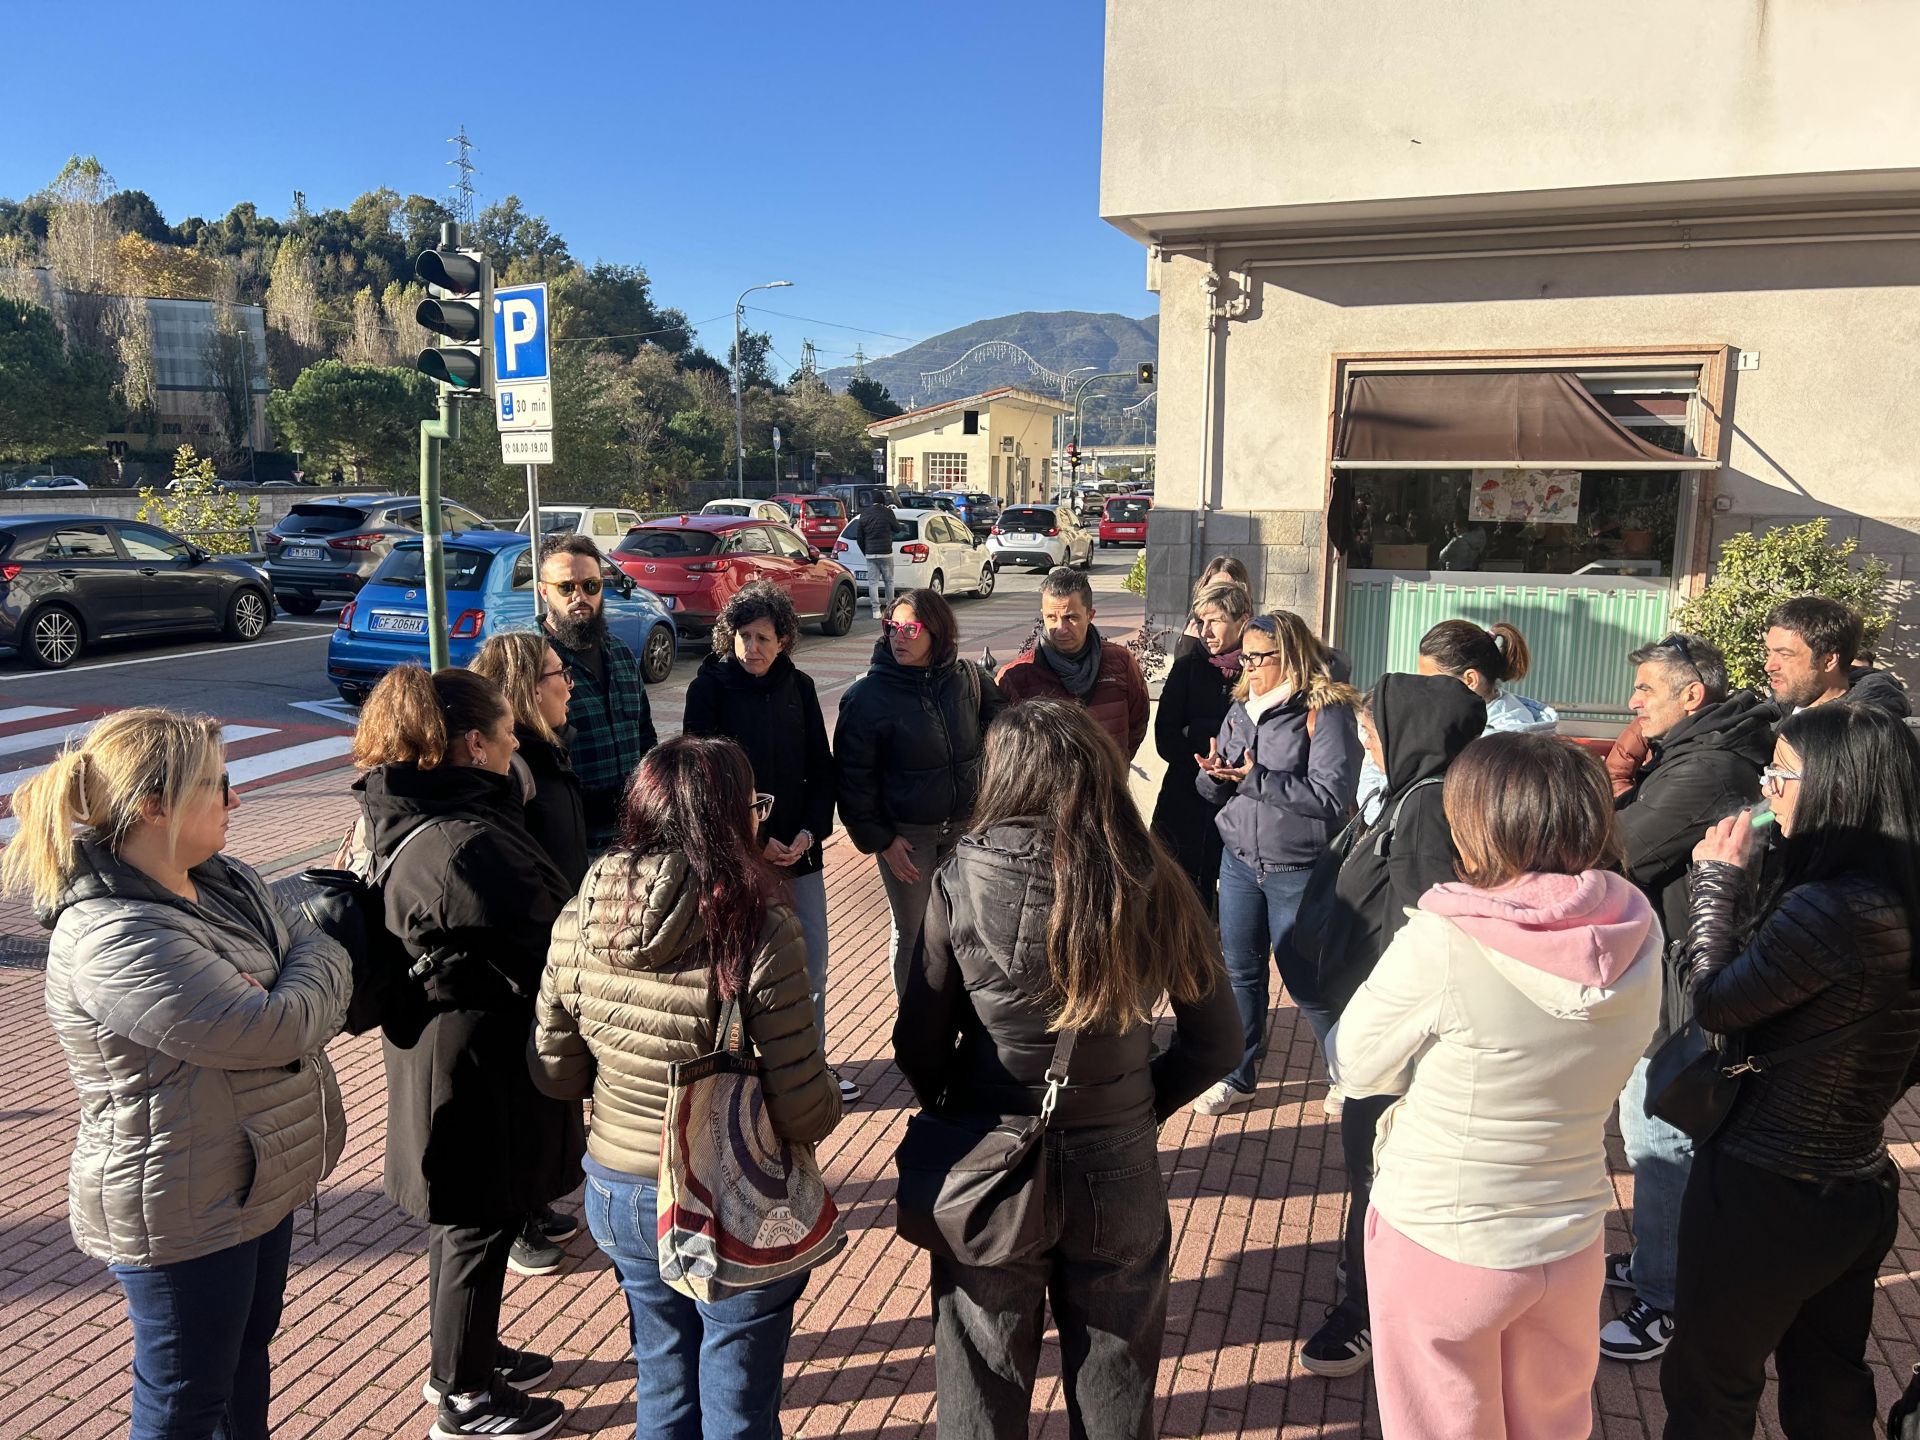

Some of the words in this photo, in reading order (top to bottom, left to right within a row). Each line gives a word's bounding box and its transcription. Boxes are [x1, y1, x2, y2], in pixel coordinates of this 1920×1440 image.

[503, 298, 537, 371] P
[1742, 354, 1748, 368] 1
[516, 399, 527, 413] 30
[531, 397, 546, 412] min
[391, 618, 421, 632] 206HX
